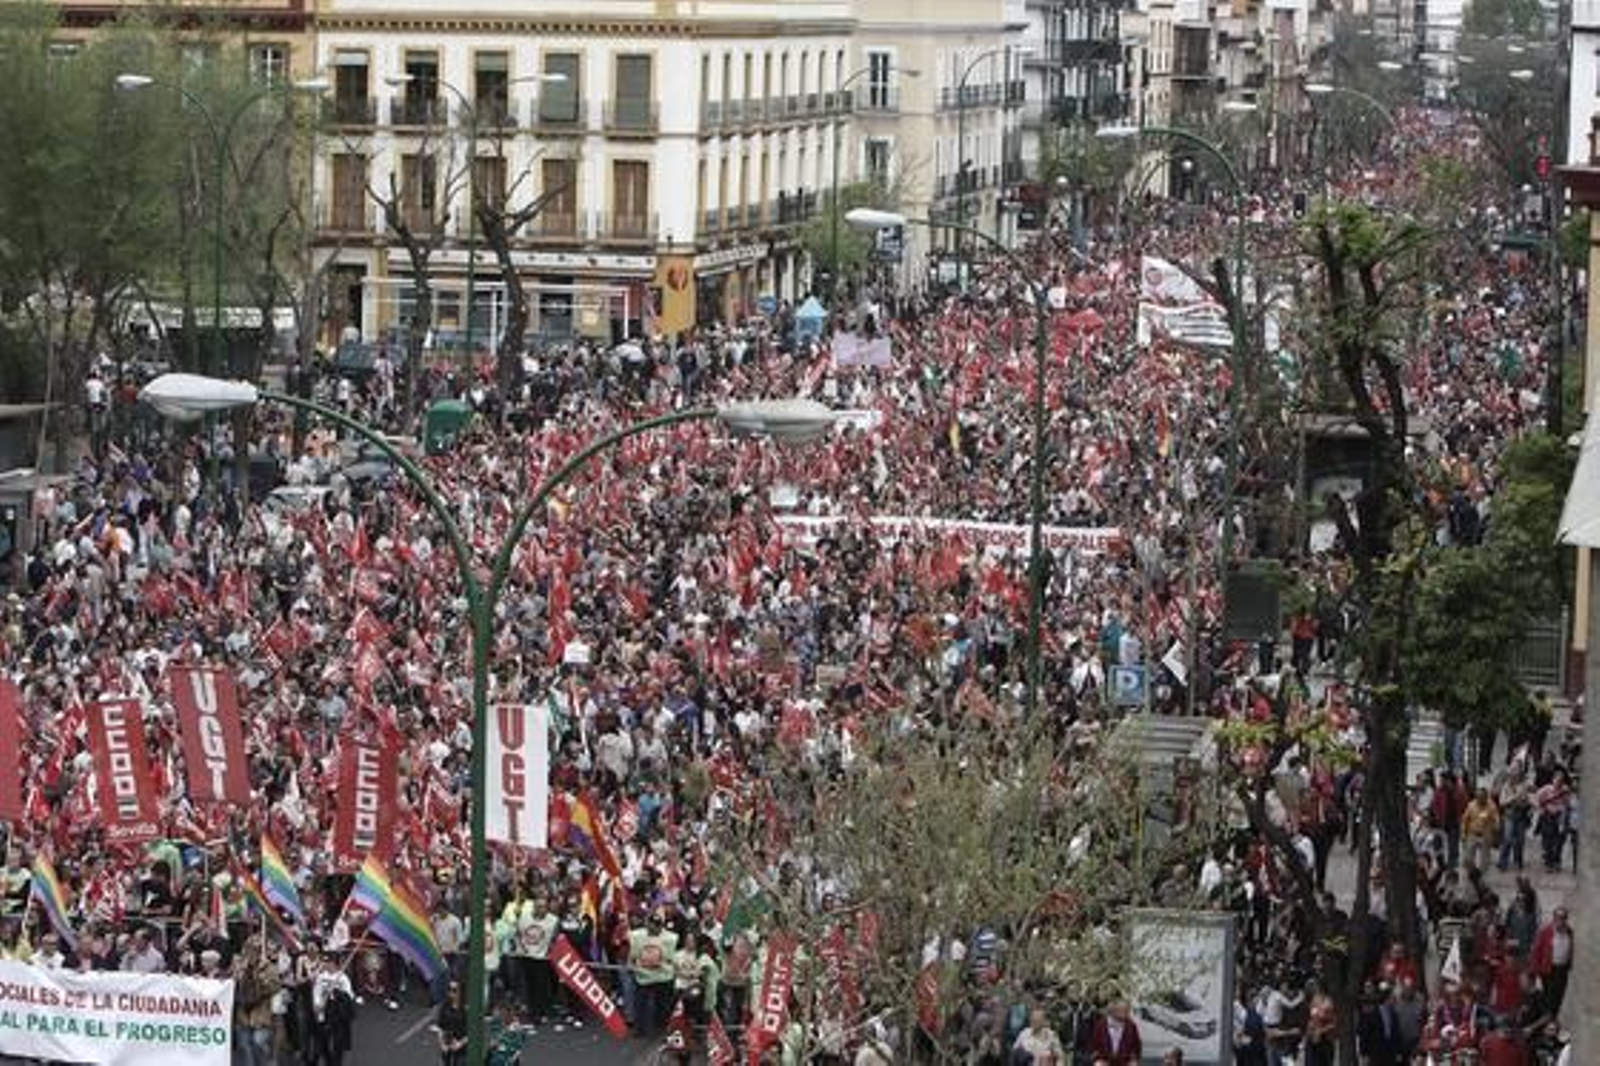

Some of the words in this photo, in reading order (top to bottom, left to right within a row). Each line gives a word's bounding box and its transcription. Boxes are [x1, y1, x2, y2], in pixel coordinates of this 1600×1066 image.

[1115, 668, 1139, 697] P
[189, 670, 228, 801] UGT
[496, 706, 526, 847] UGT
[93, 993, 114, 1011] LA
[26, 1012, 80, 1035] PARA
[84, 1018, 110, 1038] EL
[115, 1021, 227, 1046] PROGRESO
